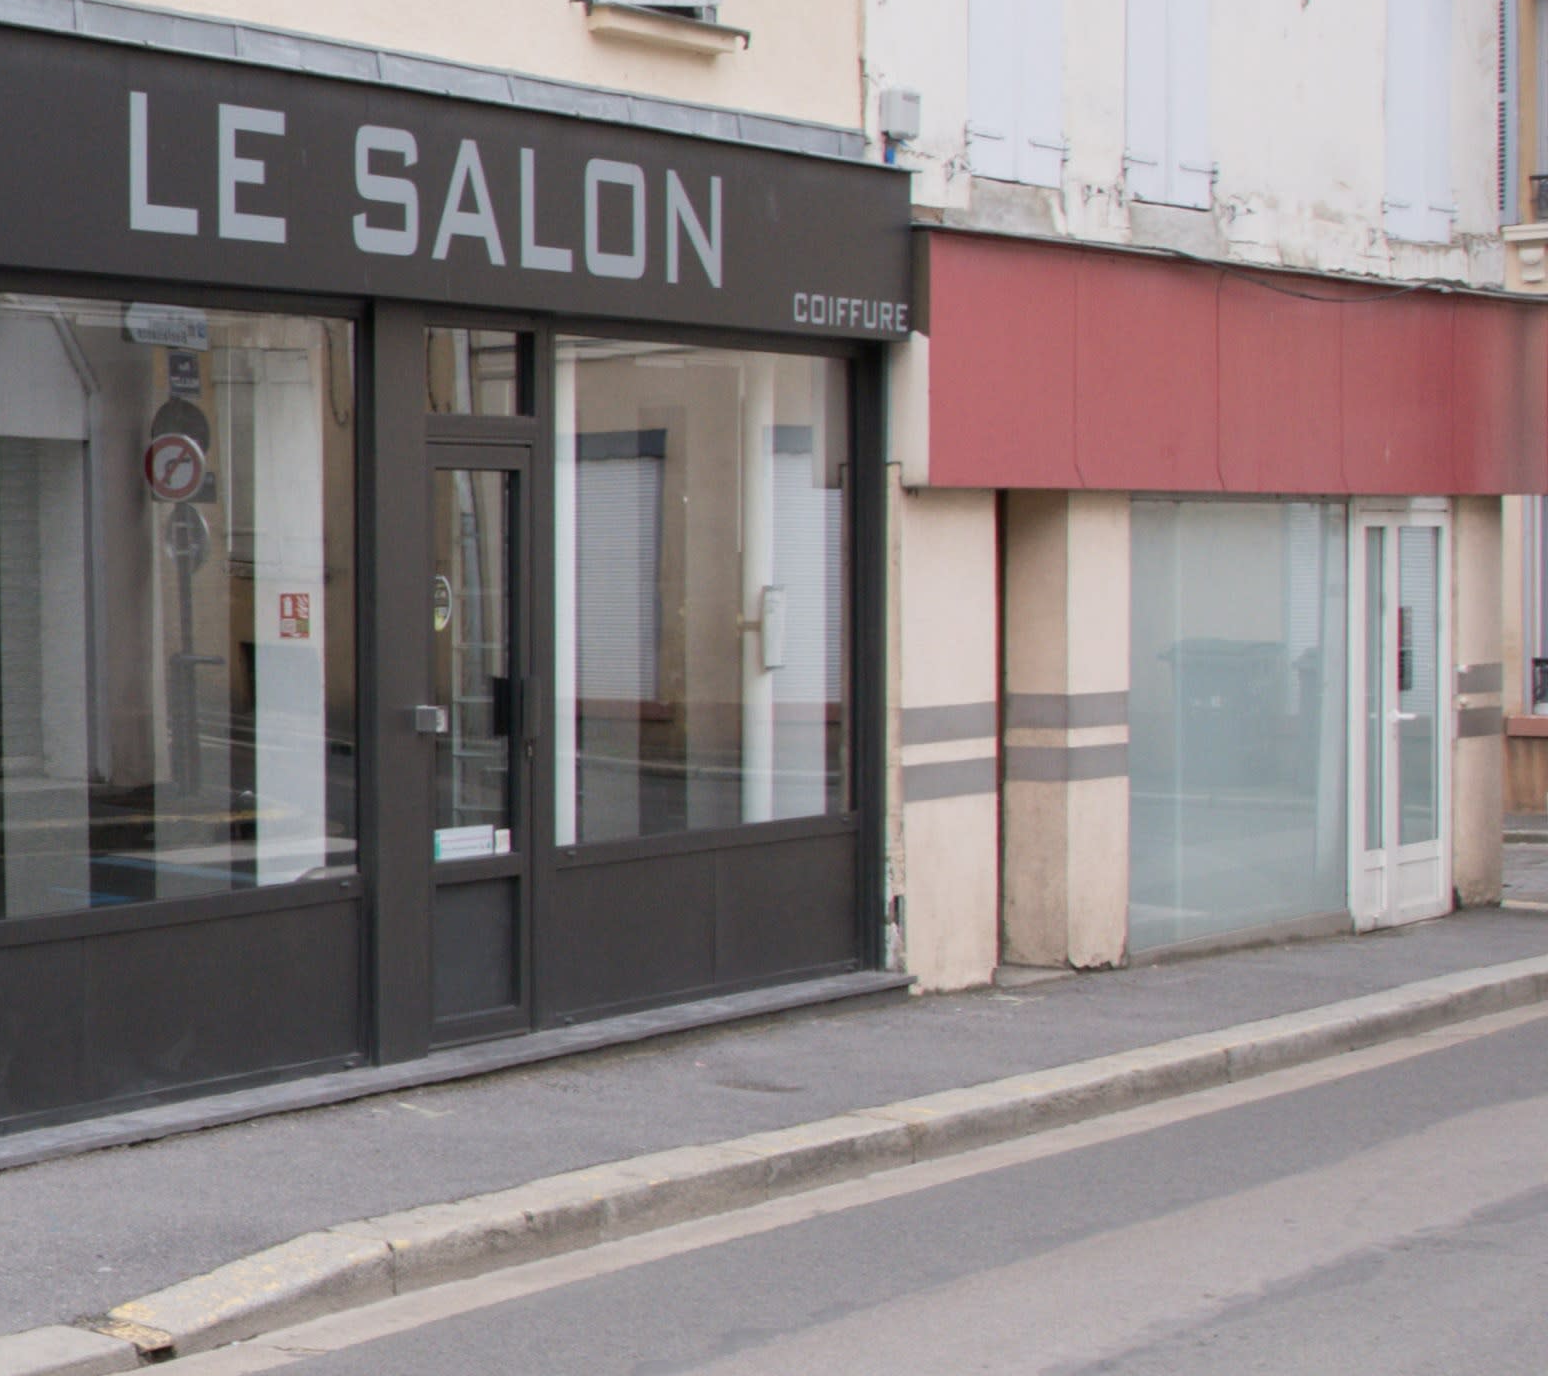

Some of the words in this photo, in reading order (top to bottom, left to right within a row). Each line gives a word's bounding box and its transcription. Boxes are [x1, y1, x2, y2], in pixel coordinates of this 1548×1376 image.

[129, 91, 287, 244] LE
[352, 124, 723, 289] SALON
[794, 292, 908, 332] COIFFURE
